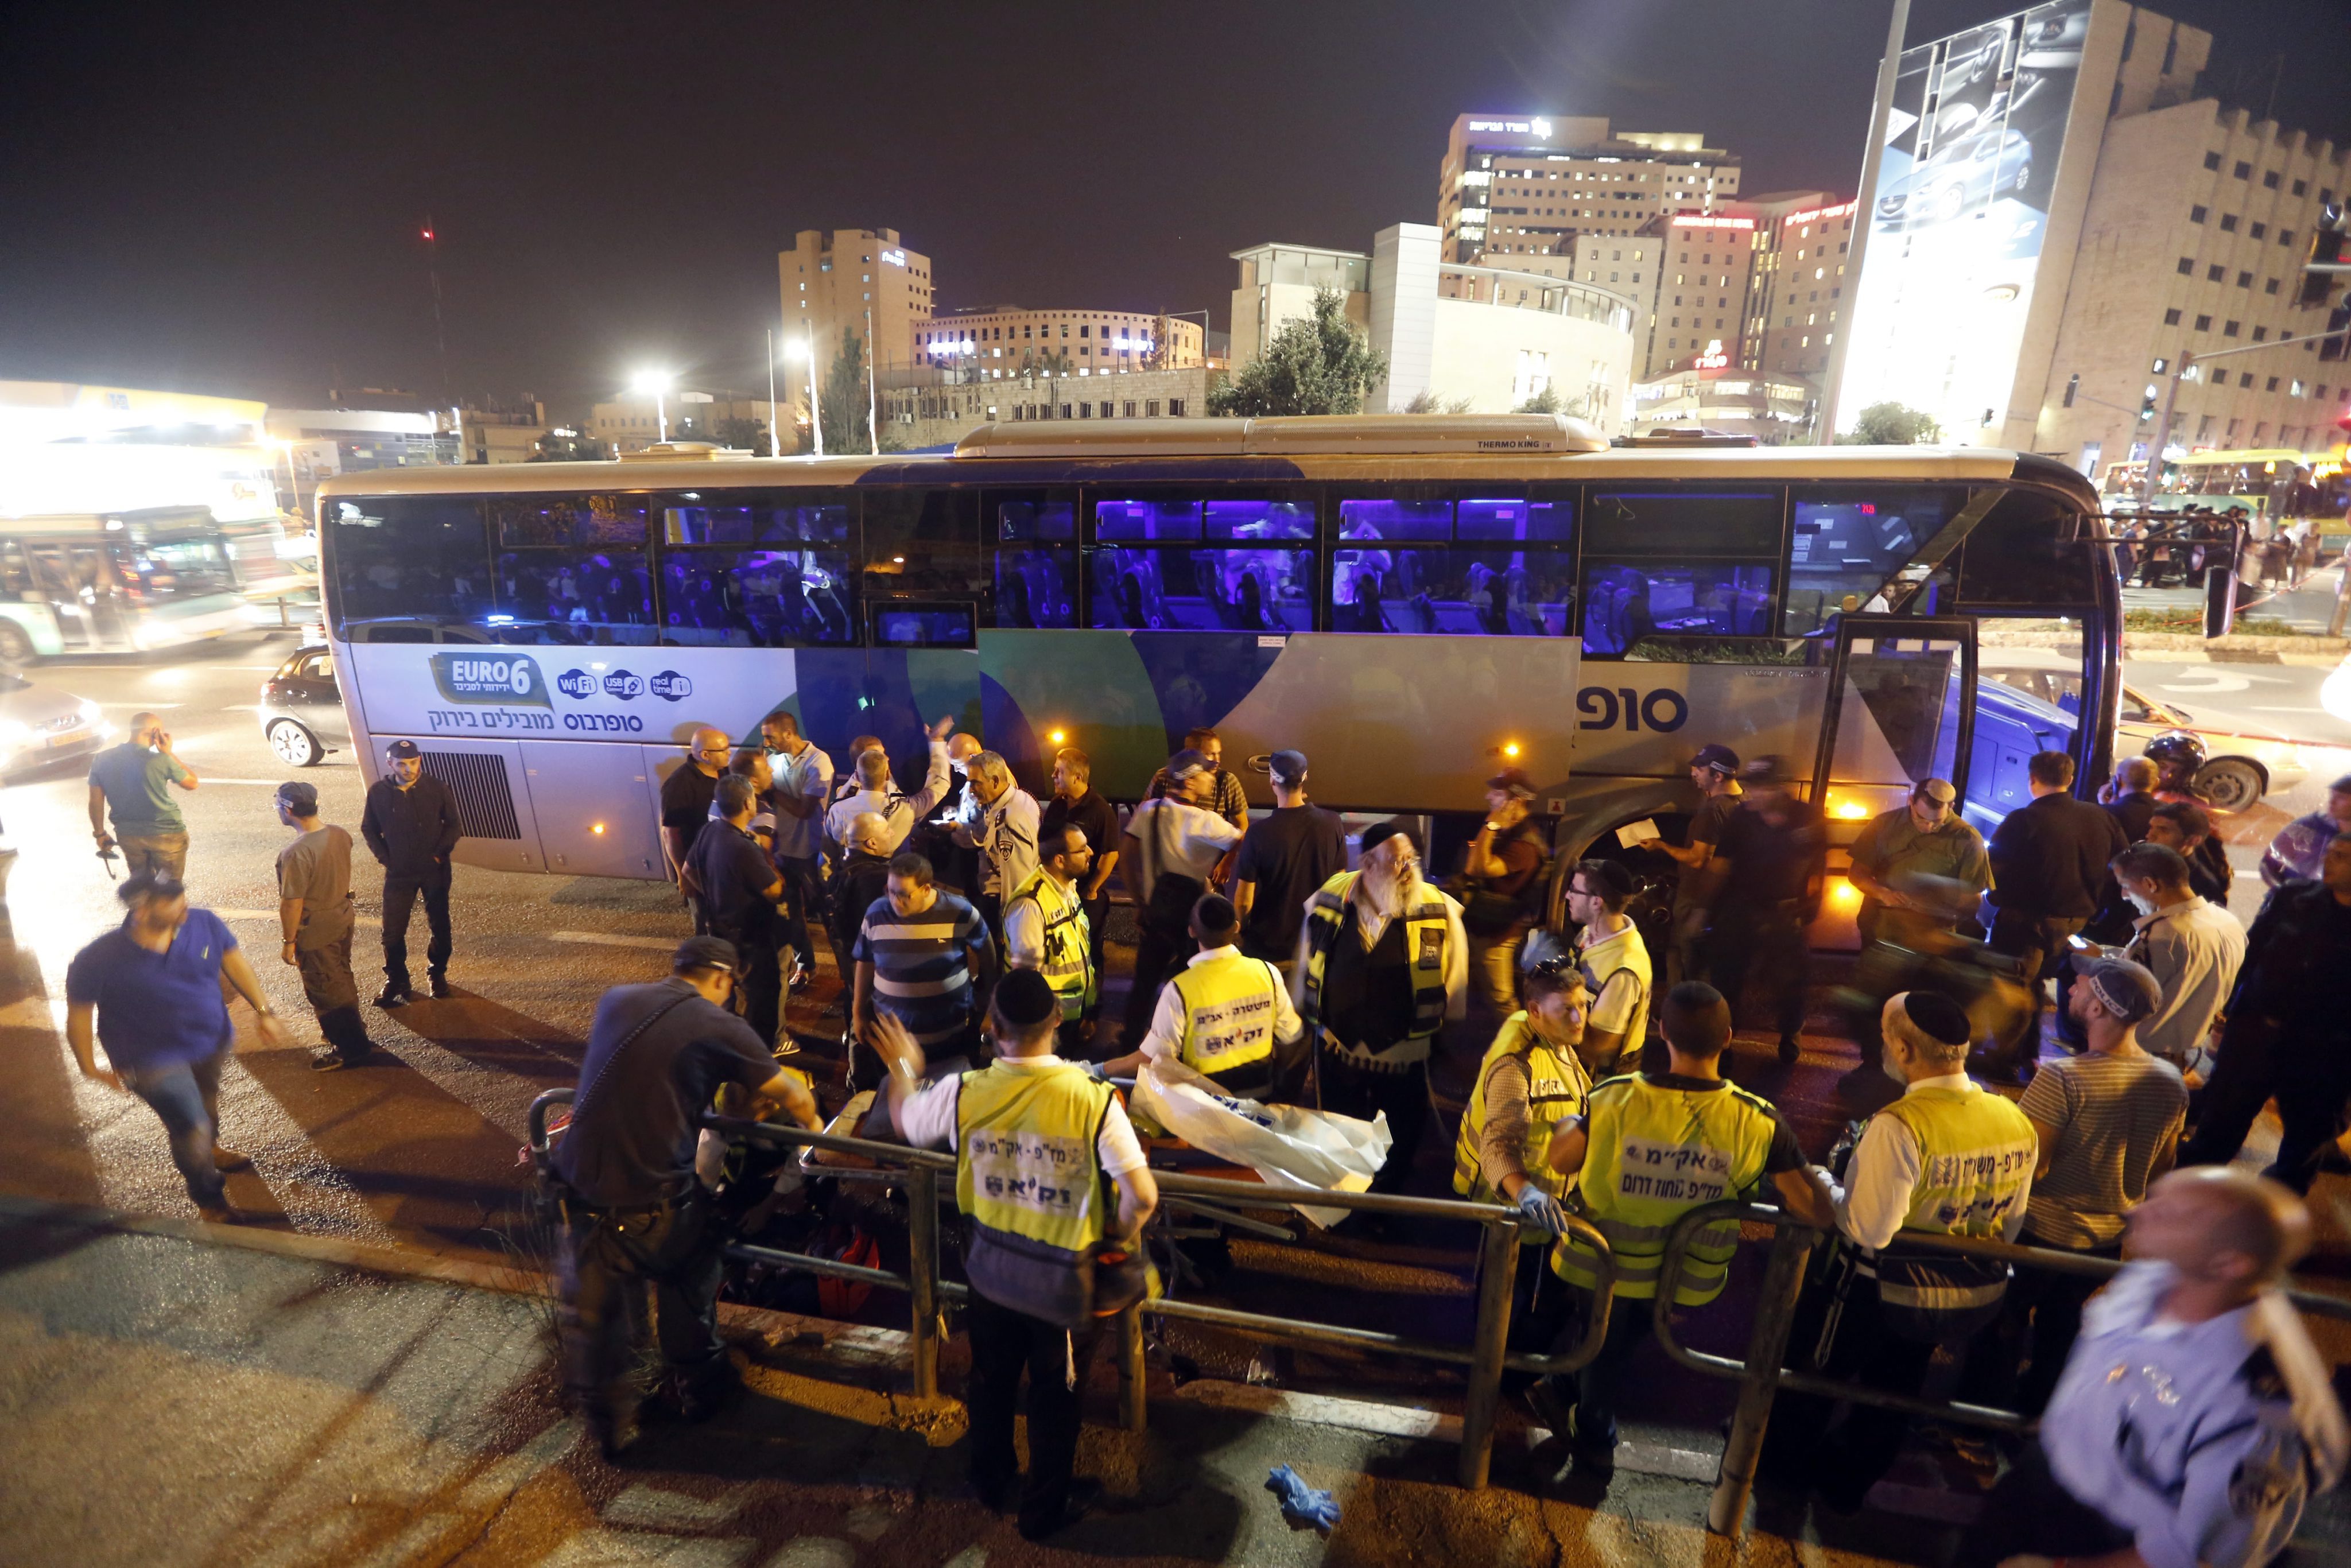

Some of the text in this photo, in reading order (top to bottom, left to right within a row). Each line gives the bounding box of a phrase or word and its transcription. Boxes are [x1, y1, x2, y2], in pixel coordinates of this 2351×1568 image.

[1477, 440, 1516, 448] THERMO
[1518, 440, 1540, 448] KING
[452, 659, 531, 694] EURO 6
[652, 677, 669, 686] real
[605, 677, 623, 687] USB
[653, 685, 672, 694] time
[427, 708, 643, 732] סופרבוס מובילים בירוק
[1621, 1174, 1652, 1195] דרום
